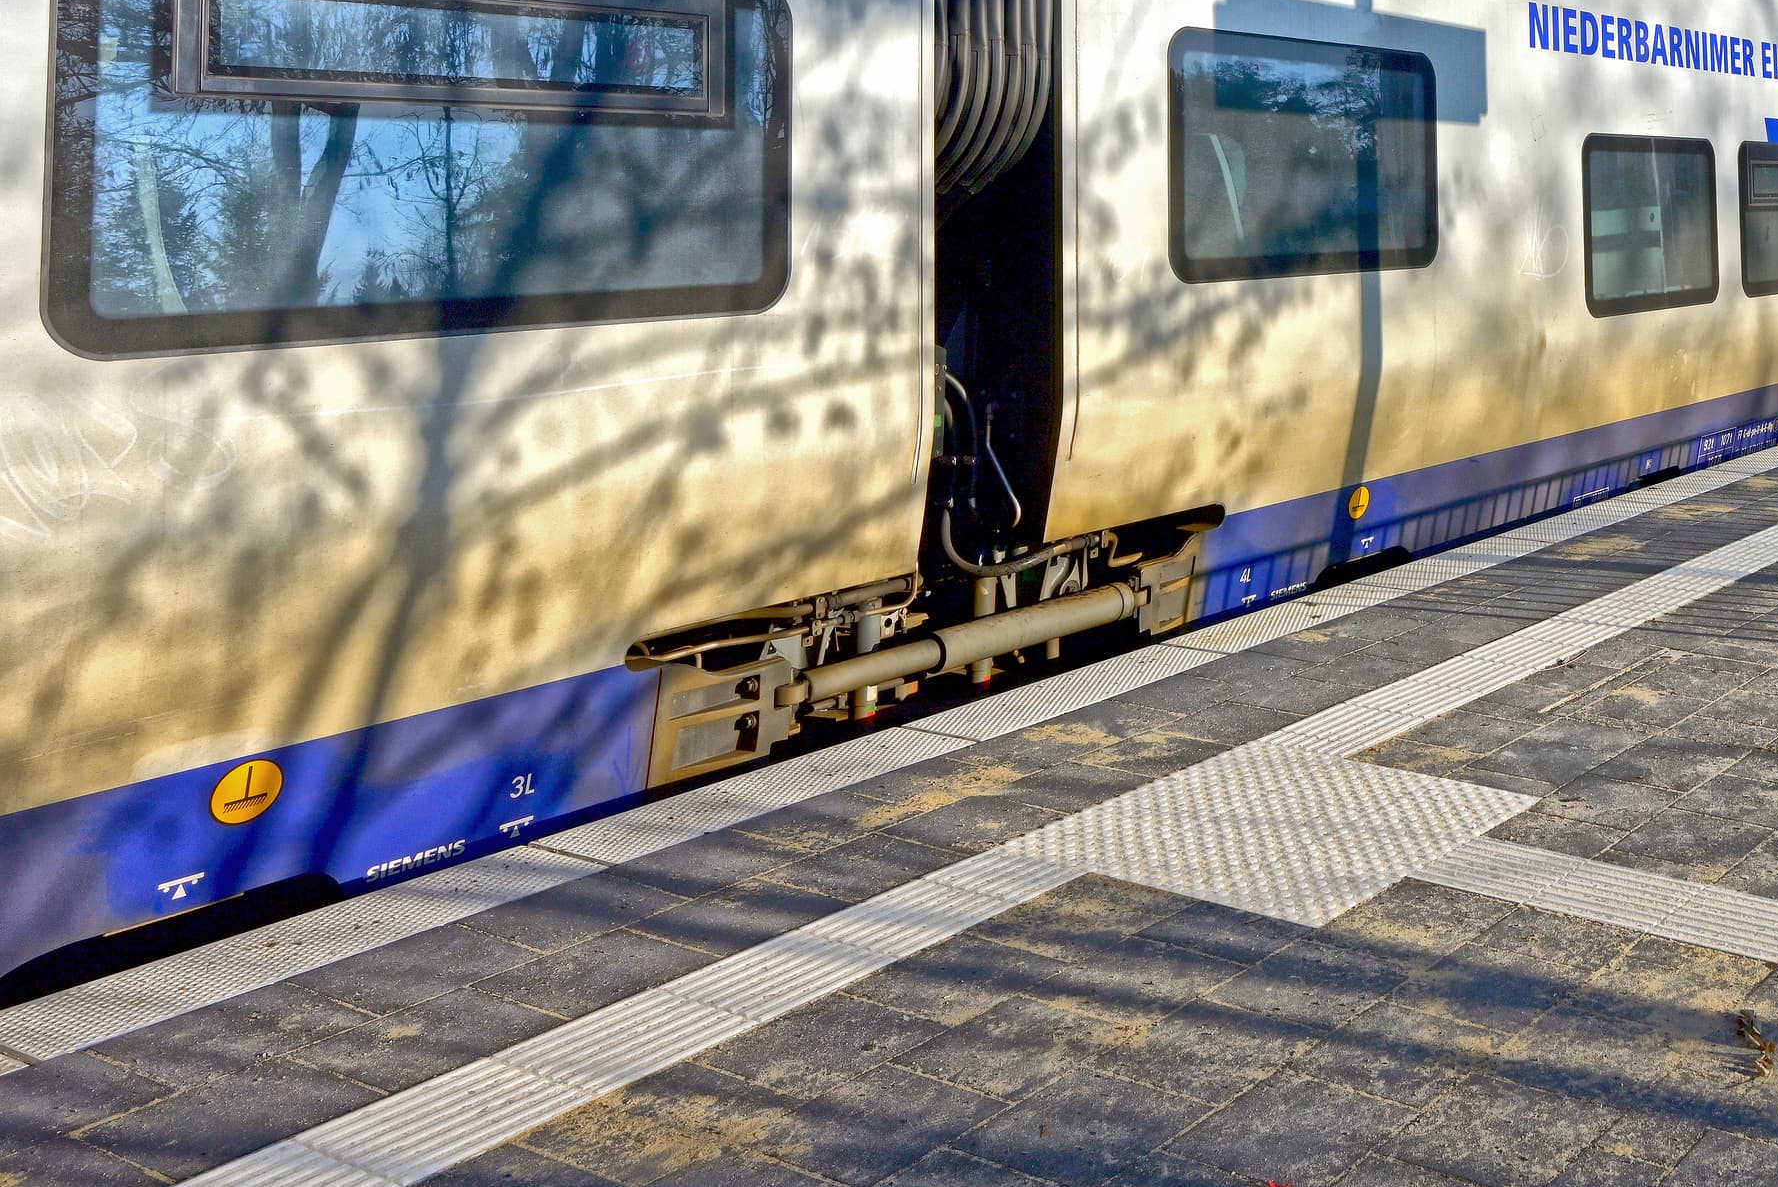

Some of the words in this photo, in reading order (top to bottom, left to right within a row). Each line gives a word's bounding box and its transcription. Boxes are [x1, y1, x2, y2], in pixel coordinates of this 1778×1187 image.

[1527, 1, 1756, 78] NIEDERBARNIMER
[1239, 567, 1252, 584] 4L
[1270, 581, 1308, 602] SIEMENS
[509, 773, 536, 800] 3L
[365, 838, 466, 884] SIEMENS
